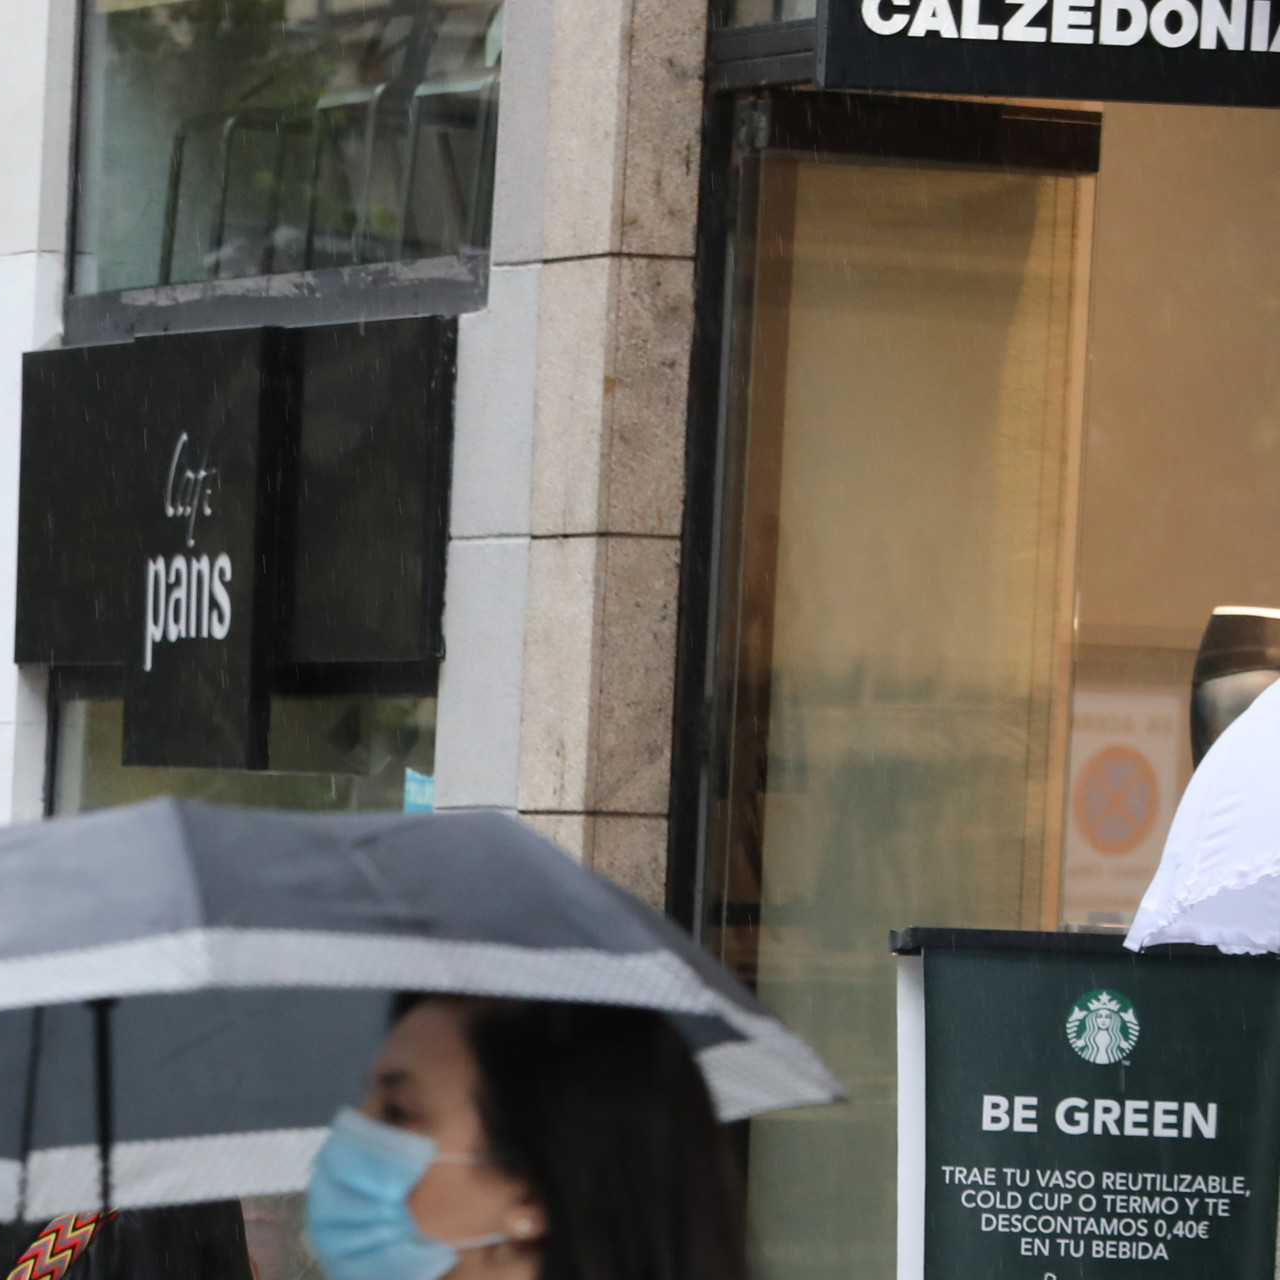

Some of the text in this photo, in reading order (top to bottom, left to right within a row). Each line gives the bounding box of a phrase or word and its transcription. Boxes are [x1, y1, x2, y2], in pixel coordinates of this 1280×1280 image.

[145, 553, 231, 671] pans
[982, 1095, 1217, 1138] BE GREEN
[942, 1166, 1250, 1197] TRAE TU VASO REUTILIZABLE,
[961, 1189, 1229, 1216] COLD CUP O TERMO Y TE
[981, 1213, 1209, 1240] DESCONTAMOS 0,40€
[1021, 1238, 1168, 1259] EN TU BEBIDA
